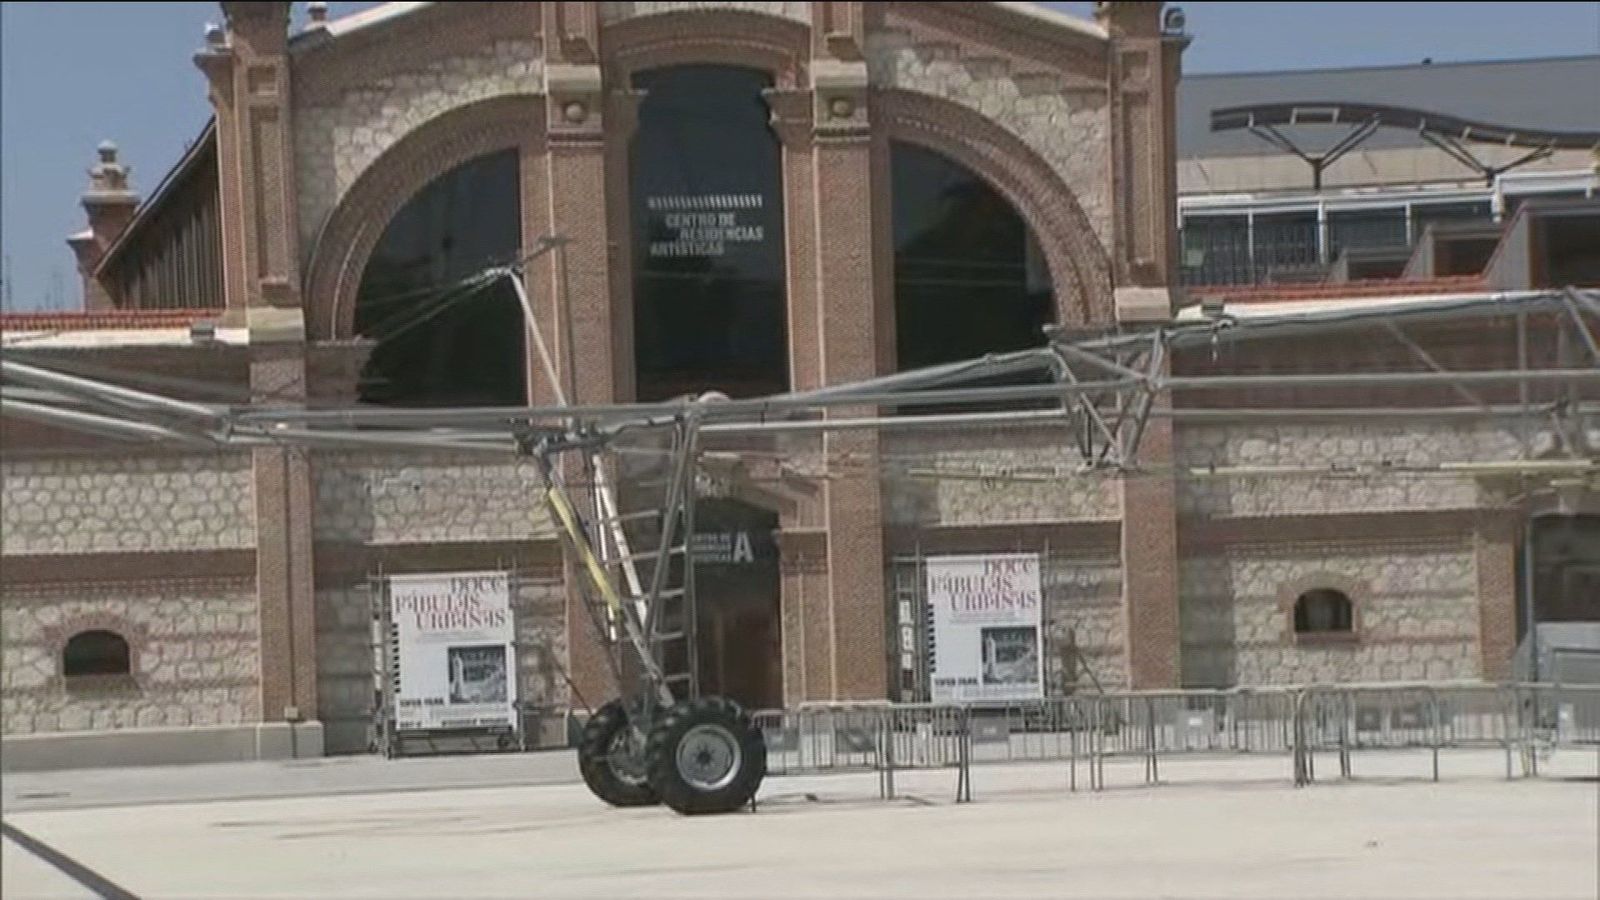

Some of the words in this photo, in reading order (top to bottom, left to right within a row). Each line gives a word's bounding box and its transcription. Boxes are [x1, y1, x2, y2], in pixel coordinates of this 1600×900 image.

[665, 212, 717, 228] CENTRO
[718, 212, 735, 227] DE
[679, 226, 764, 242] RESIDENCIAS
[732, 531, 754, 563] A
